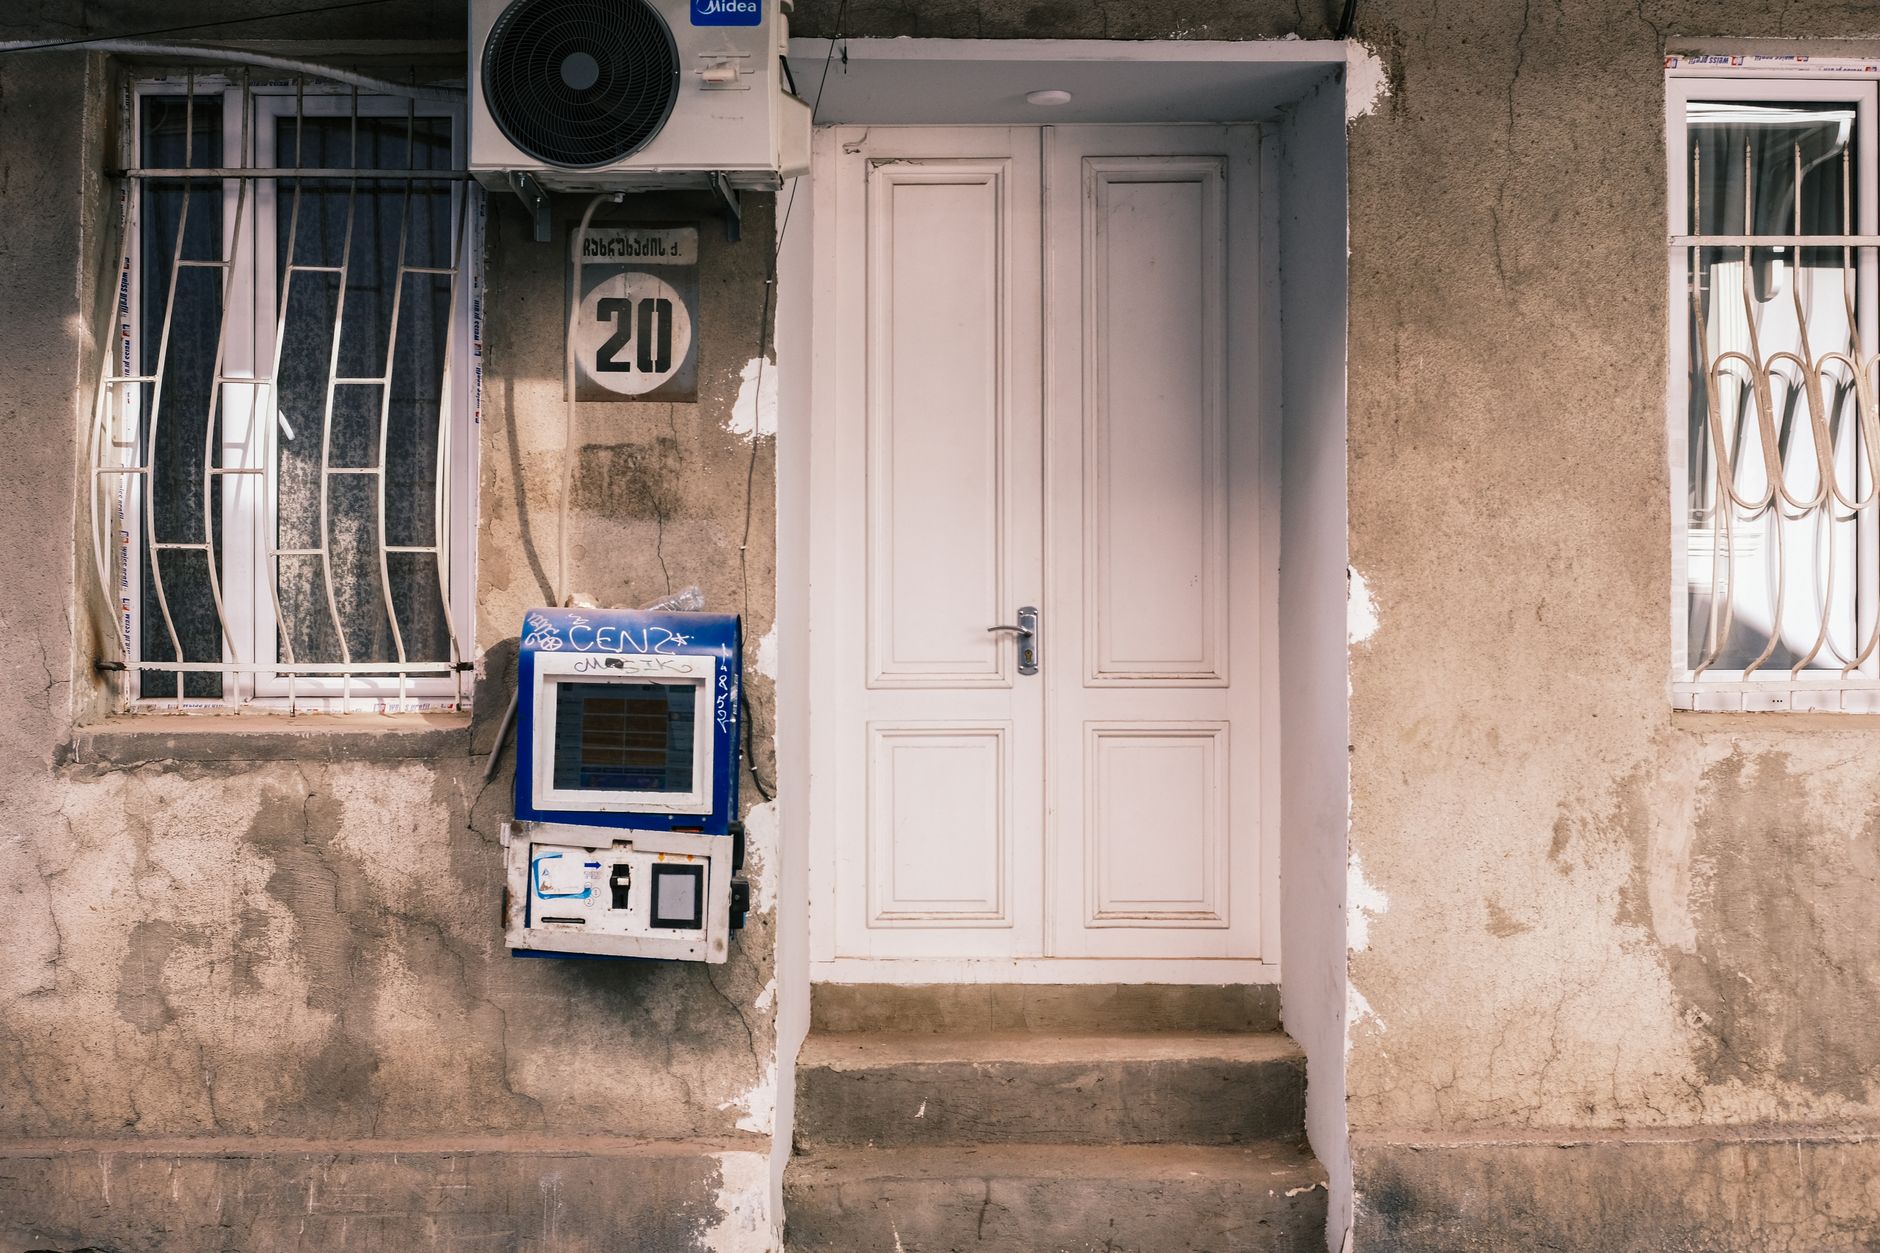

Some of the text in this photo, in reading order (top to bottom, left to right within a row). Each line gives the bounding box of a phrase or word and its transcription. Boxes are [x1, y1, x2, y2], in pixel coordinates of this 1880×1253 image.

[697, 0, 757, 14] Midea
[596, 297, 672, 373] 20
[574, 657, 693, 674] MSIK
